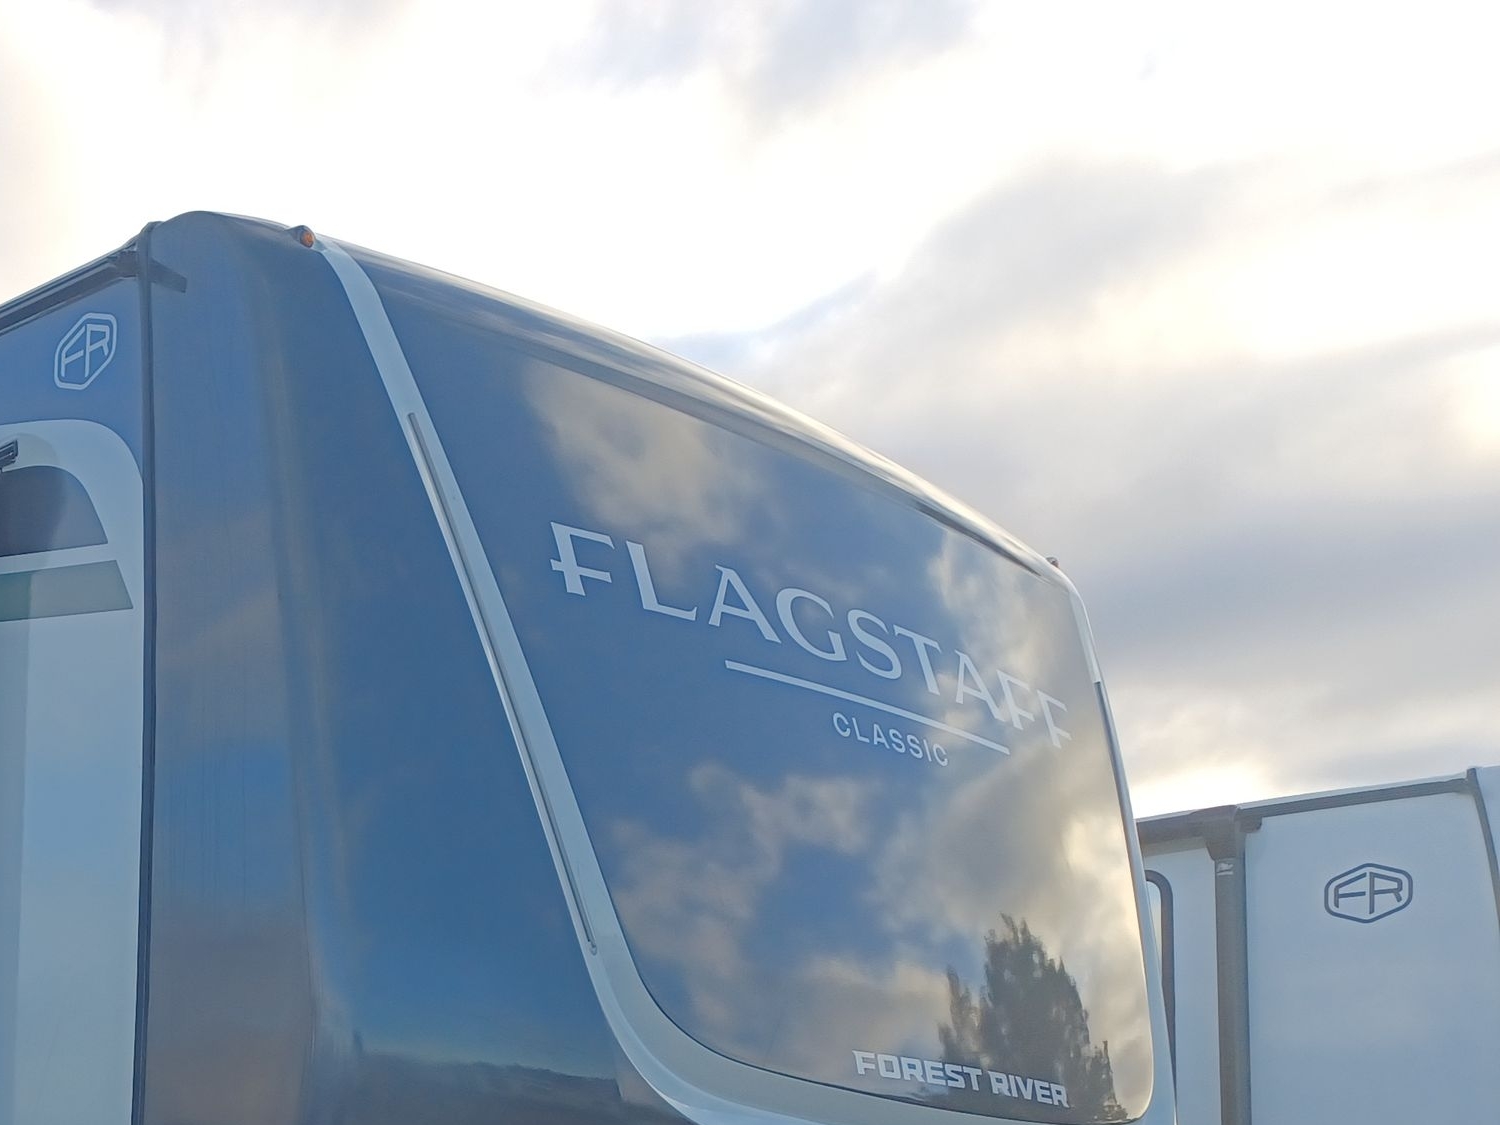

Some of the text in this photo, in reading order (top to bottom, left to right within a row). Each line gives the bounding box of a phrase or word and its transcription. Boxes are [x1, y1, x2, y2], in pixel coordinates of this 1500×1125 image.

[550, 521, 1072, 749] FLAGSTAFF
[832, 711, 949, 767] CLASSIC
[851, 1049, 1070, 1109] FOREST RIVER
